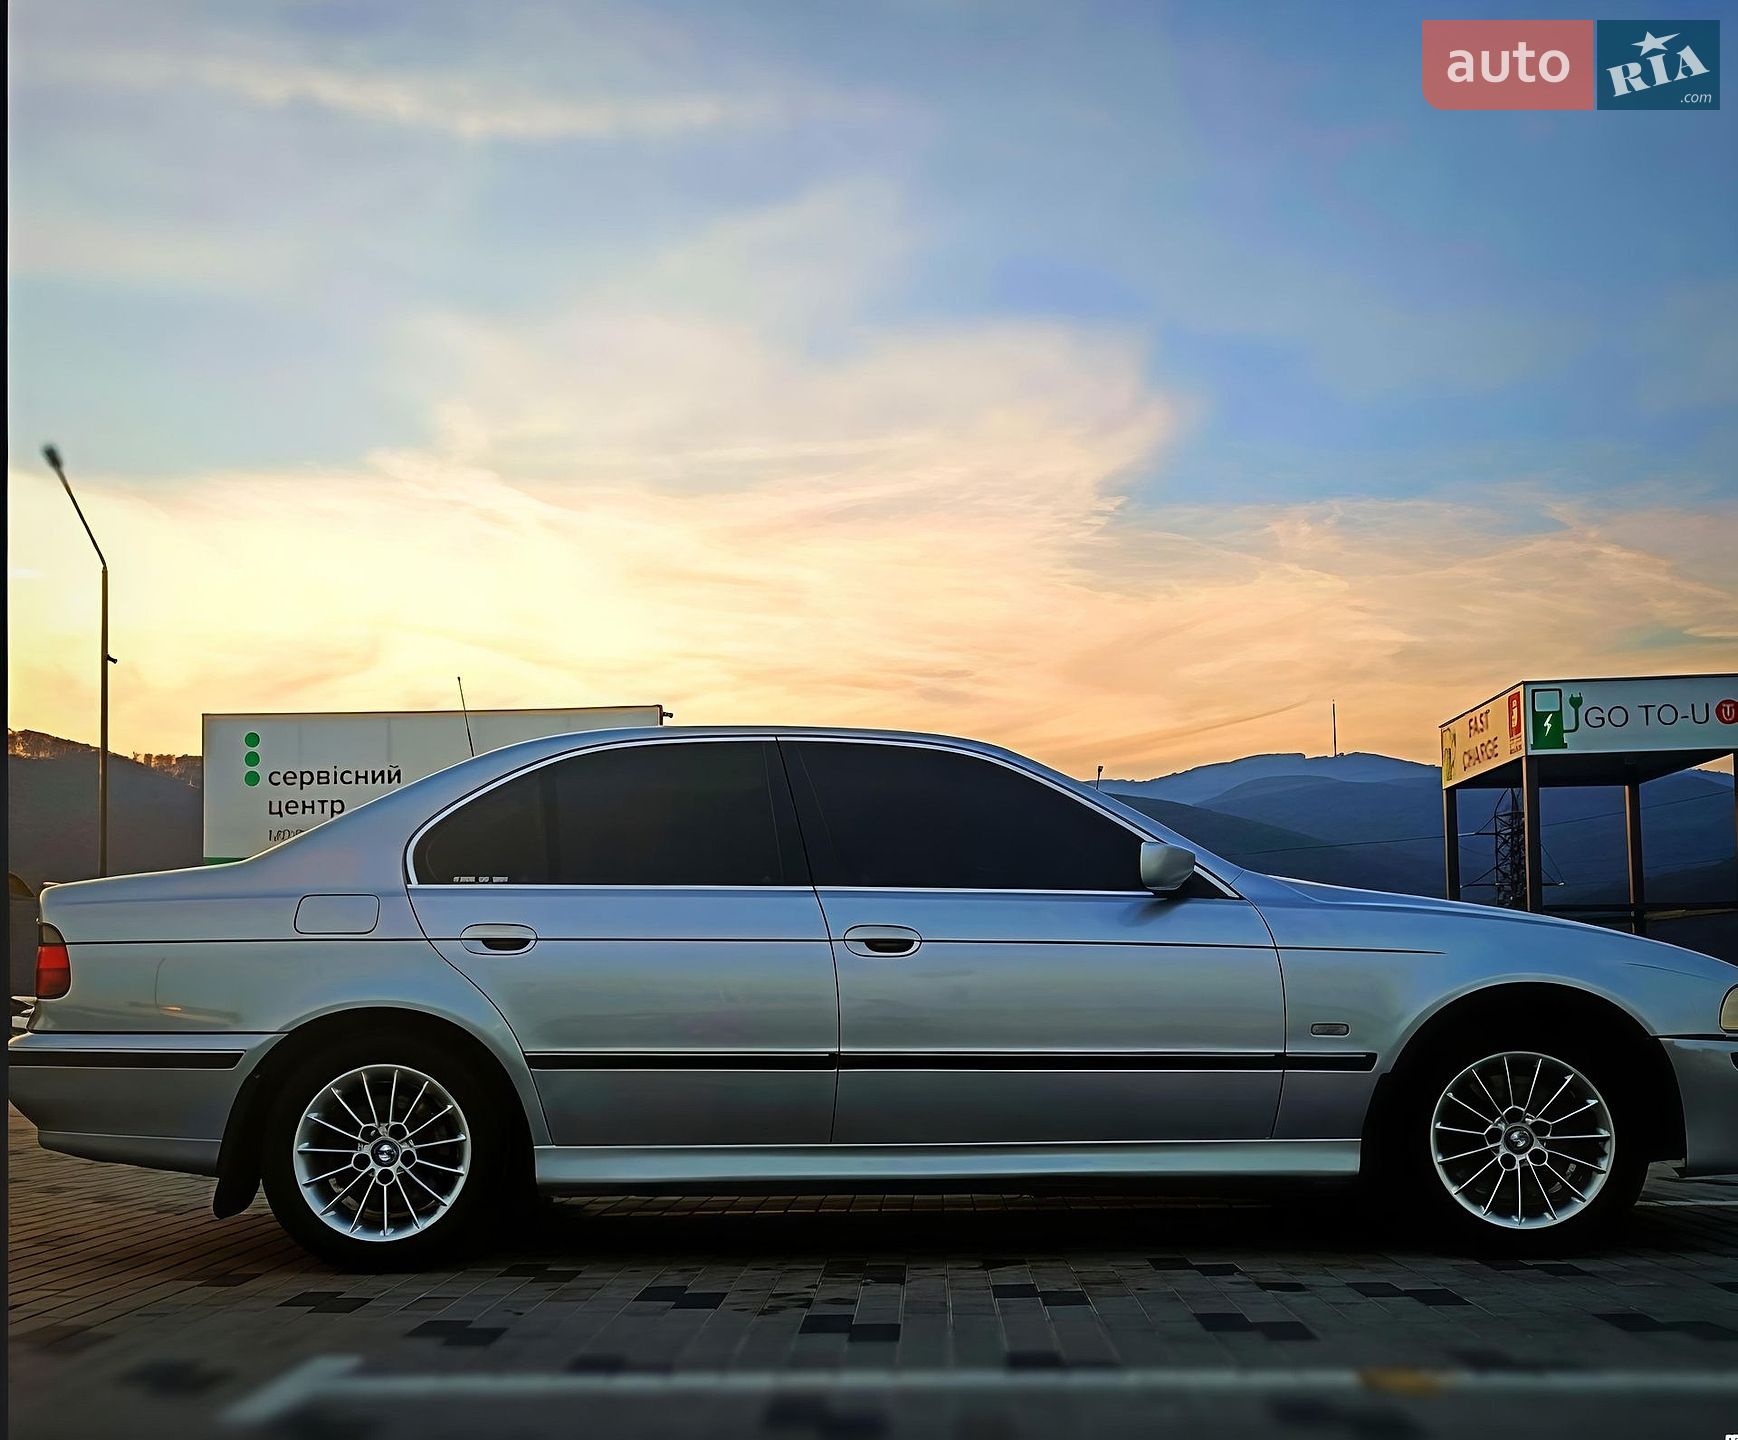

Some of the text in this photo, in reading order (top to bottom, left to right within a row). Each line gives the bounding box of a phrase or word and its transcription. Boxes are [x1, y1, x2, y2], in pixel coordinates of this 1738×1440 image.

[1468, 708, 1491, 738] FAST
[1584, 706, 1629, 729] GO
[1637, 702, 1710, 726] TO-U
[1462, 736, 1499, 772] CHARGE
[268, 765, 402, 790] сервісний
[268, 799, 345, 818] центр
